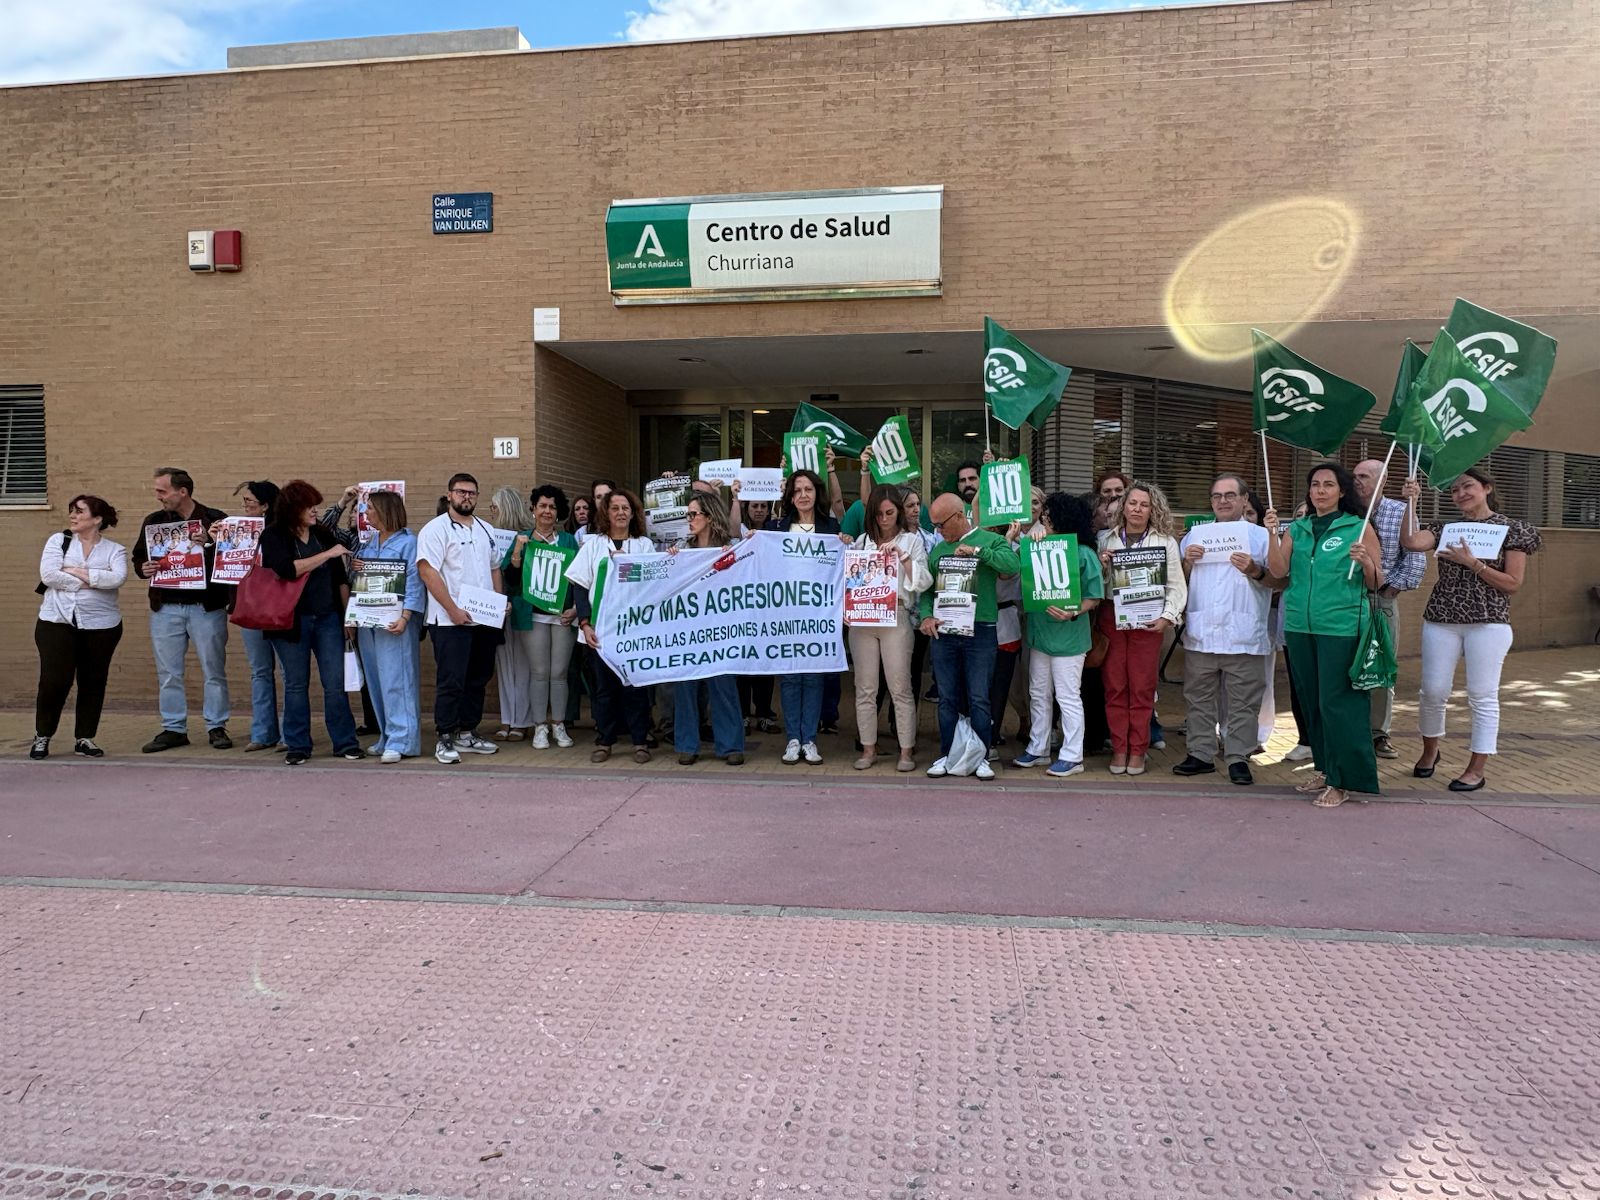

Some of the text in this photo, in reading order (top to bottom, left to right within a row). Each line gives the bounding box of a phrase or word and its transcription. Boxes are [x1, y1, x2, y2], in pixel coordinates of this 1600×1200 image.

[434, 197, 455, 206] Calle
[434, 208, 473, 219] ENRIQUE
[434, 220, 489, 230] VAN DULKEN
[706, 214, 891, 242] Centro de Salud
[648, 259, 684, 268] Andalucía
[707, 253, 794, 271] Churriana
[988, 358, 1026, 389] CSIF
[1263, 378, 1325, 413] CSIF
[1436, 397, 1478, 441] CSIF
[500, 441, 513, 456] 18
[872, 430, 908, 469] NO
[790, 443, 819, 474] NO
[995, 462, 1022, 473] AGRESIÓN
[988, 470, 1022, 508] NO
[653, 511, 685, 520] RESPETO
[996, 504, 1023, 514] SOLUCIÓN
[782, 537, 827, 556] SMA
[1030, 539, 1068, 551] LA AGRESIÓN
[1203, 545, 1243, 553] GRESIONES
[643, 558, 675, 569] SINDICATO
[1112, 553, 1166, 563] RECOMENDADO
[155, 567, 203, 581] AGRESIONES
[530, 556, 562, 594] NO
[1030, 550, 1070, 591] NO
[854, 585, 890, 598] RESPETO
[1033, 588, 1071, 600] ES SOLUCIÓN
[1123, 590, 1161, 600] RESPETO
[659, 592, 699, 622] MAS
[704, 580, 834, 615] AGRESIONES!!
[846, 610, 895, 620] PROFESIONALES
[616, 619, 836, 653] CONTRA LAS AGRESIONES A SANITARIOS
[765, 641, 837, 660] CERO!!
